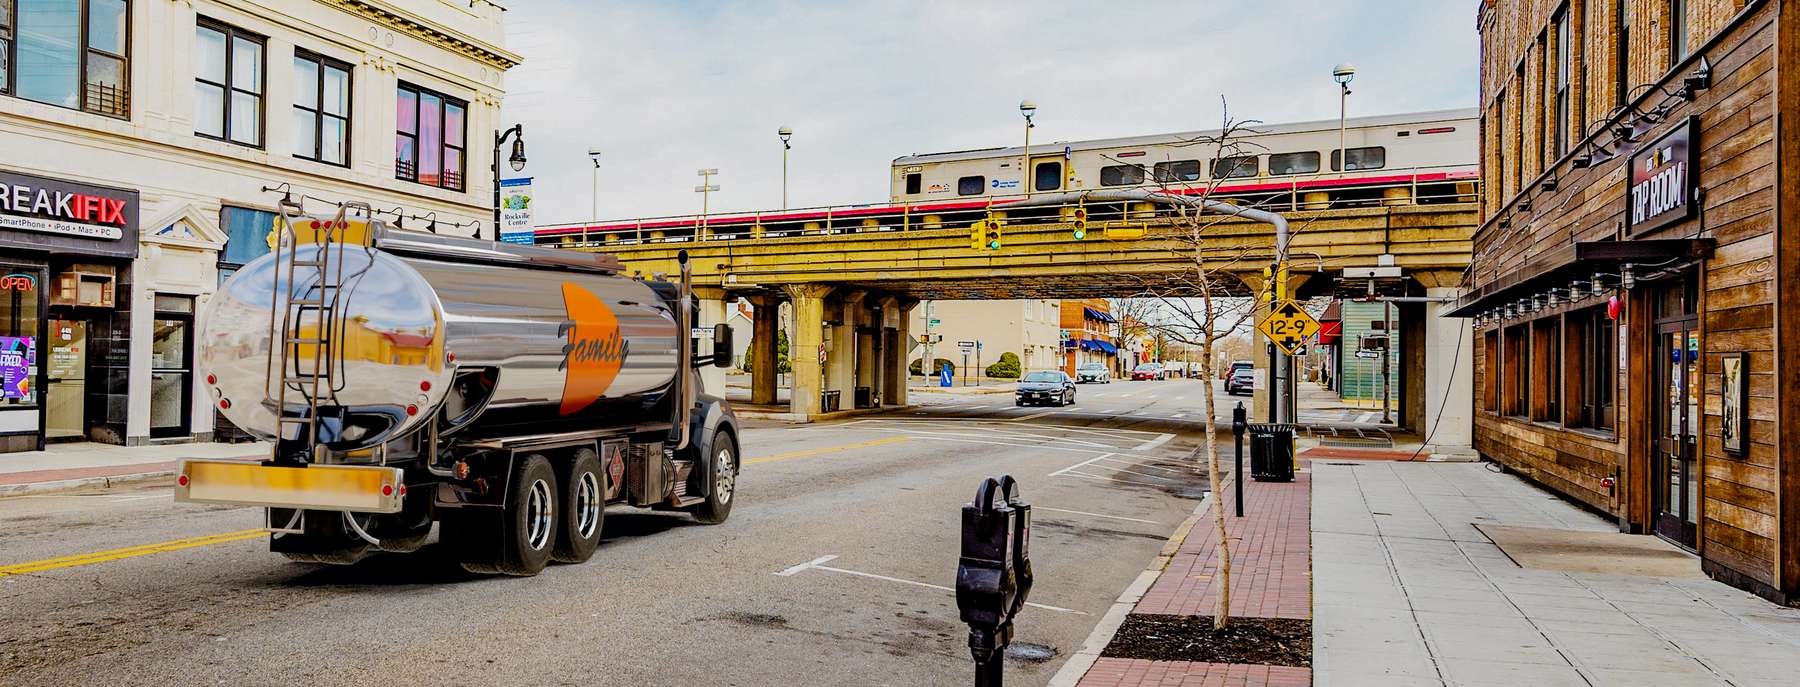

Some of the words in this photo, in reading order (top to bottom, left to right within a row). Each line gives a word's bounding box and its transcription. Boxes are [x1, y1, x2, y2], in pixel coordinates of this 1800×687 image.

[1632, 181, 1649, 225] TAP
[1649, 162, 1682, 218] ROOM
[504, 212, 530, 220] Rockville
[54, 223, 70, 232] iPod
[78, 226, 93, 234] Mac
[0, 276, 33, 291] OPEN
[557, 320, 630, 372] Family
